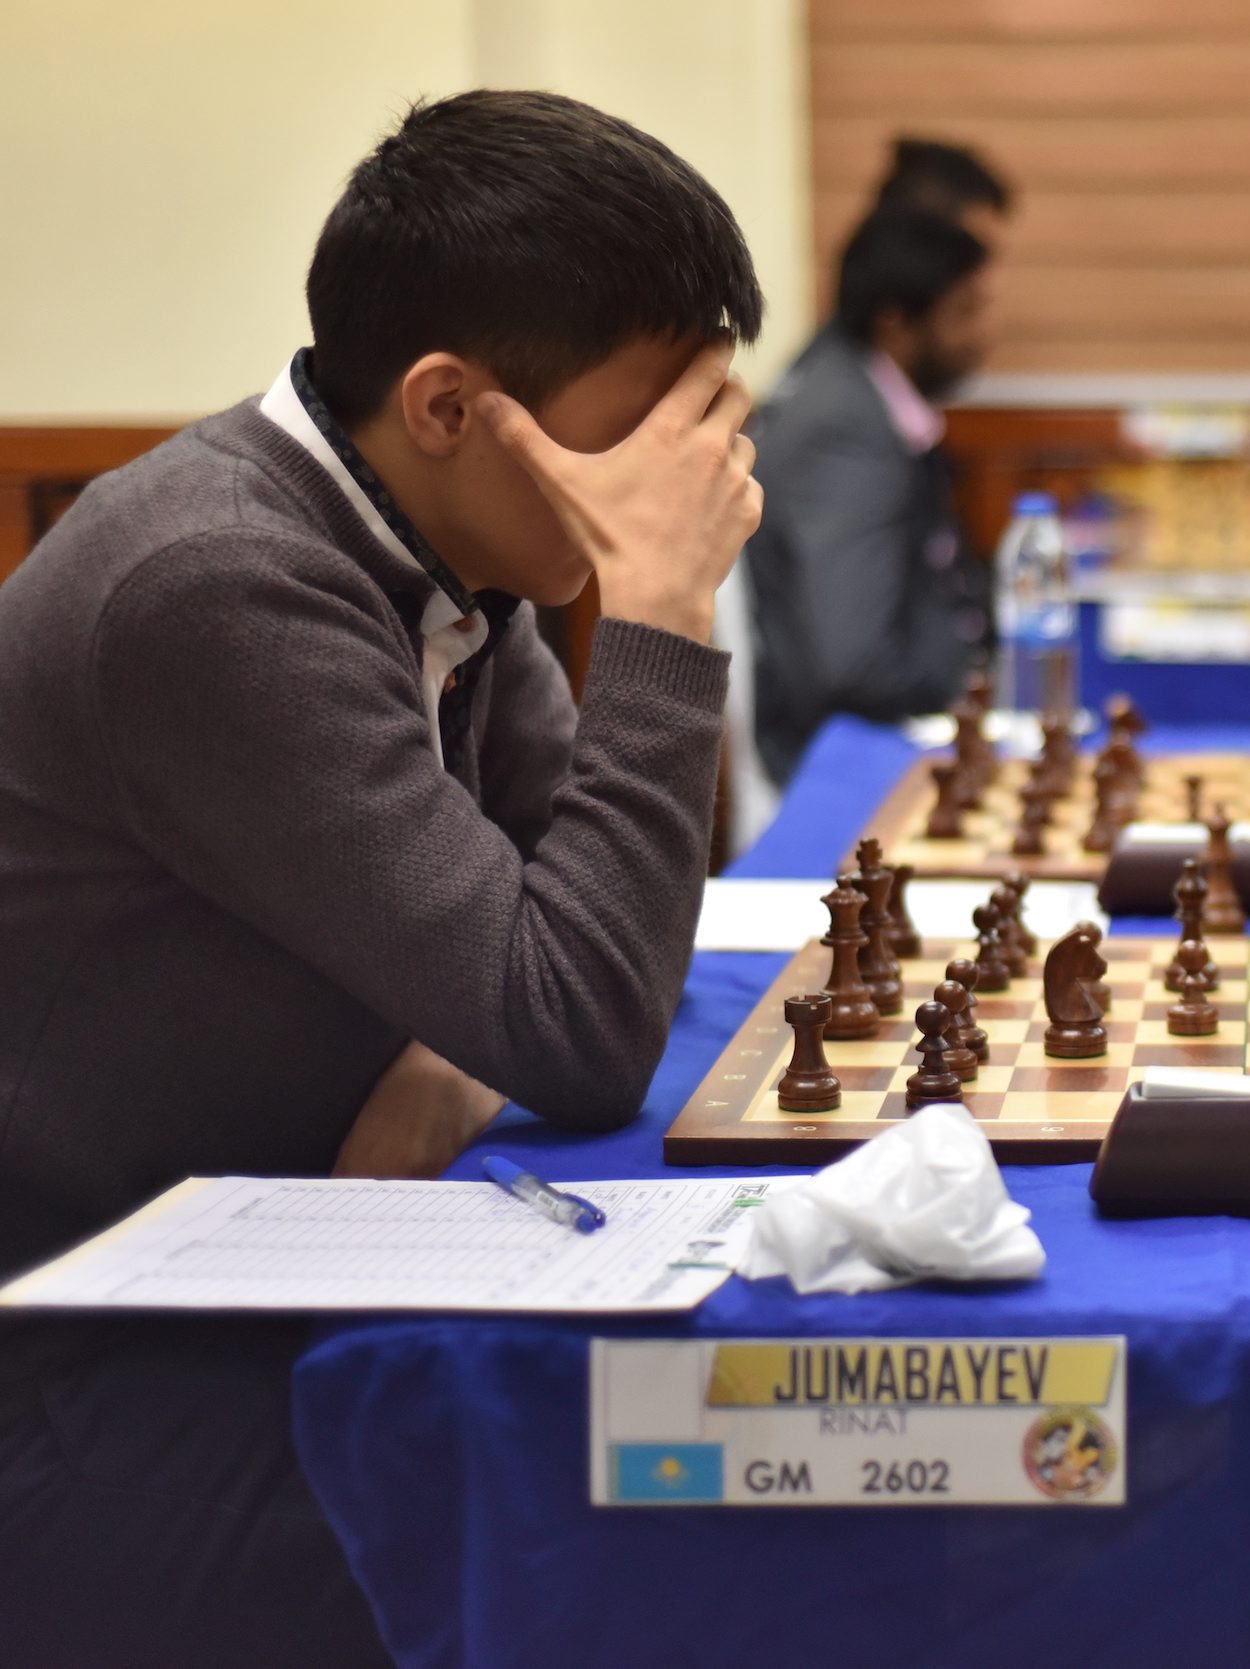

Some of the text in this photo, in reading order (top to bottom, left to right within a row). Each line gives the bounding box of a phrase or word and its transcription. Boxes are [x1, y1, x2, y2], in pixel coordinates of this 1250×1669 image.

[704, 1099, 730, 1107] A
[774, 1345, 1048, 1402] JUMABAYEV
[818, 1409, 911, 1436] RINAT
[744, 1460, 950, 1493] GM 2602
